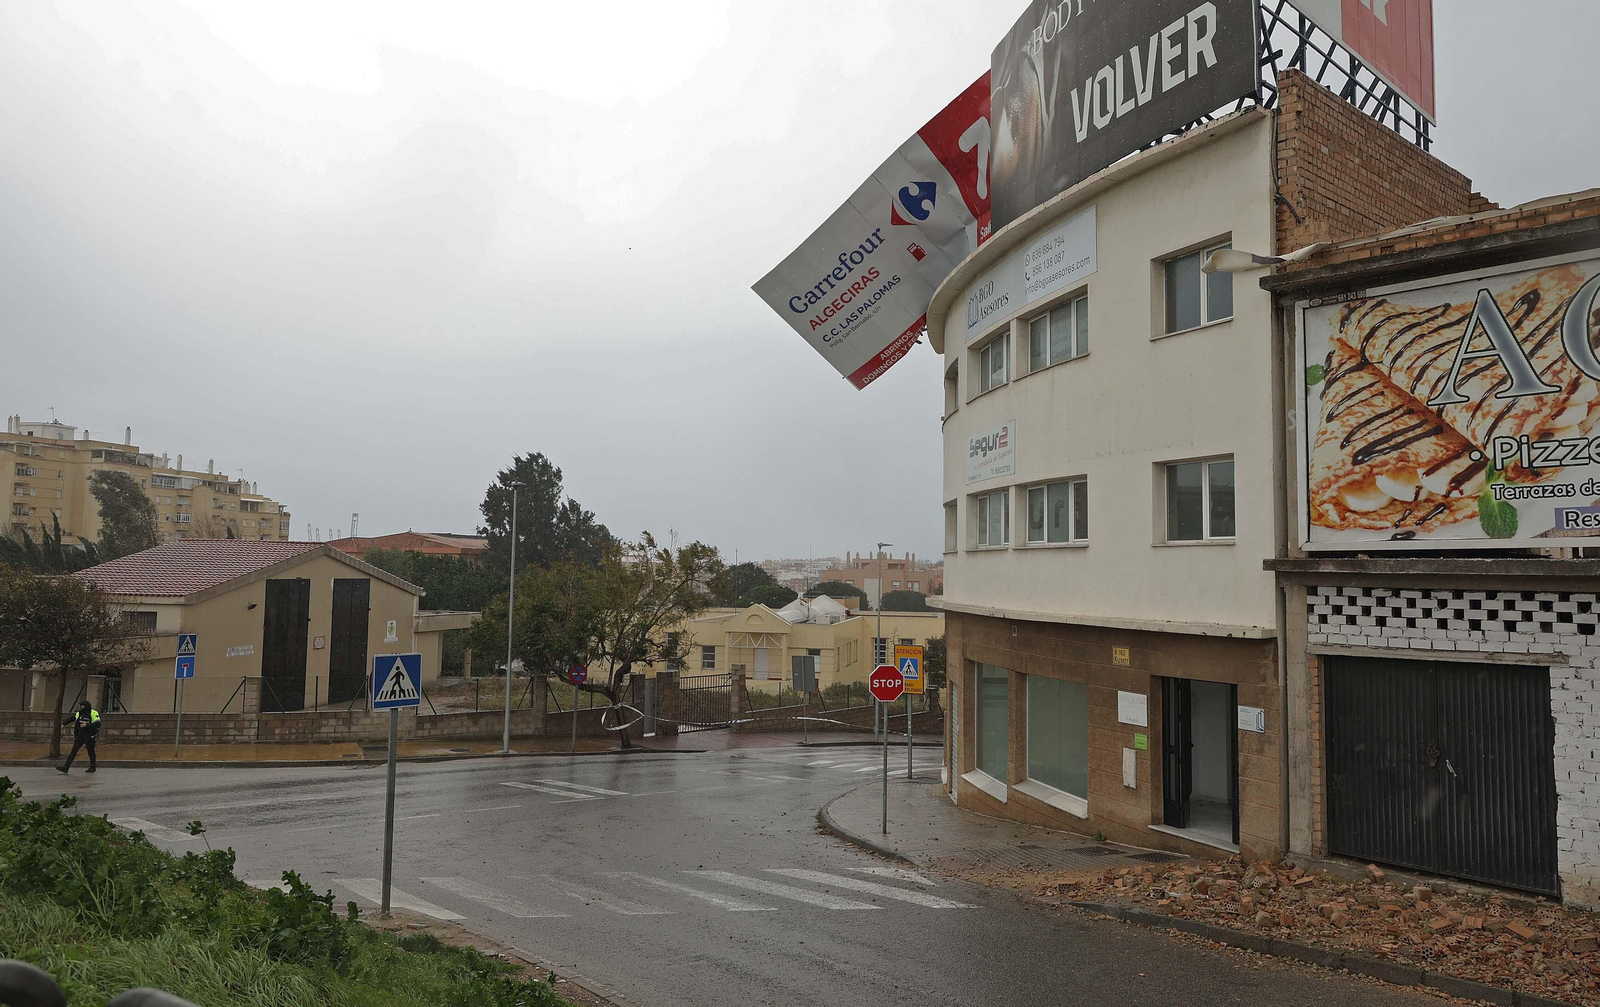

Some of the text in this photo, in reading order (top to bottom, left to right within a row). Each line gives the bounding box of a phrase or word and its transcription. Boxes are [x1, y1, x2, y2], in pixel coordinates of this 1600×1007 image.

[1070, 1, 1217, 143] VOLVER
[789, 228, 885, 313] Carrefour
[809, 266, 880, 331] ALGECIRAS
[979, 281, 994, 303] BGO
[980, 292, 1009, 320] Asesores
[822, 274, 901, 342] C.C. LAS PALOMAS
[880, 331, 914, 361] ABRIMOS
[862, 351, 902, 383] DOMINGOS
[1491, 483, 1576, 501] Terrazas
[873, 679, 902, 688] STOP
